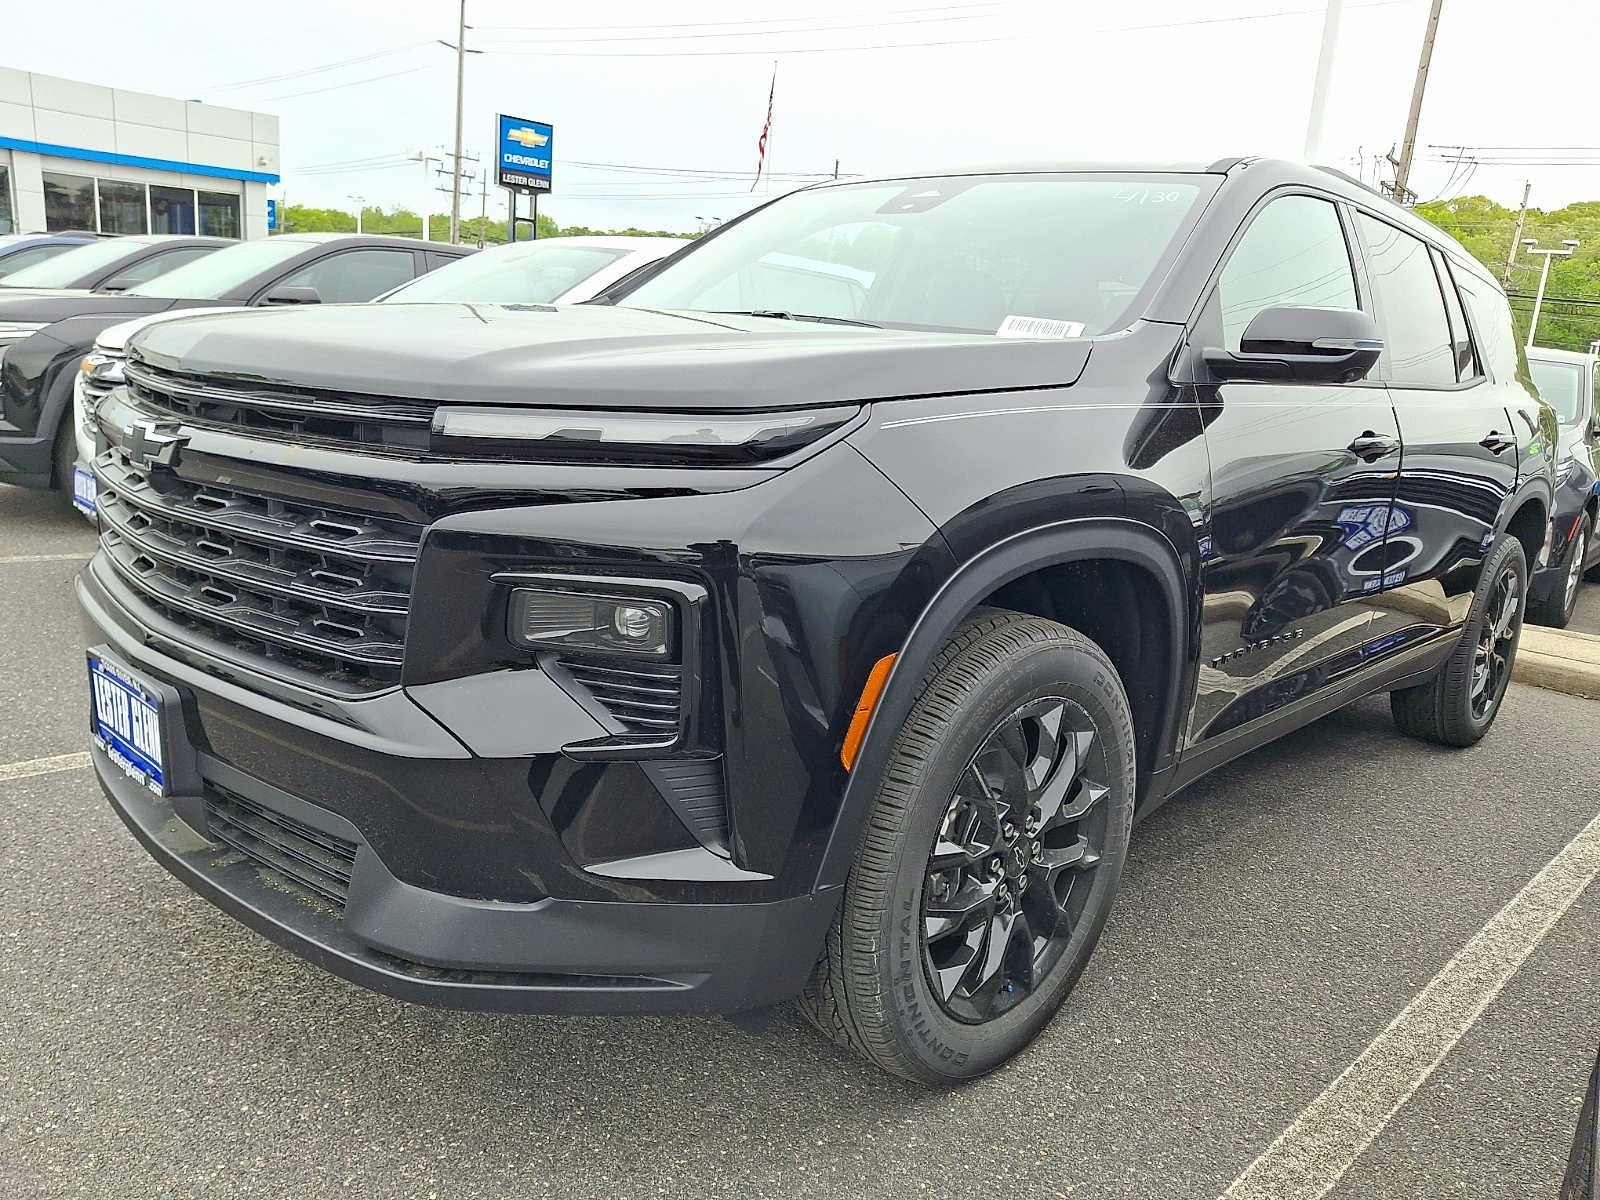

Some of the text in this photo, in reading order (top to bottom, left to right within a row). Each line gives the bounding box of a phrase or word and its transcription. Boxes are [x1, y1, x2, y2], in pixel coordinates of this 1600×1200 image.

[503, 174, 549, 188] LESTER GLENN
[504, 154, 549, 168] CHEVROLET
[93, 672, 162, 766] LESTER GLENN
[899, 887, 970, 1067] CONTINENTAL
